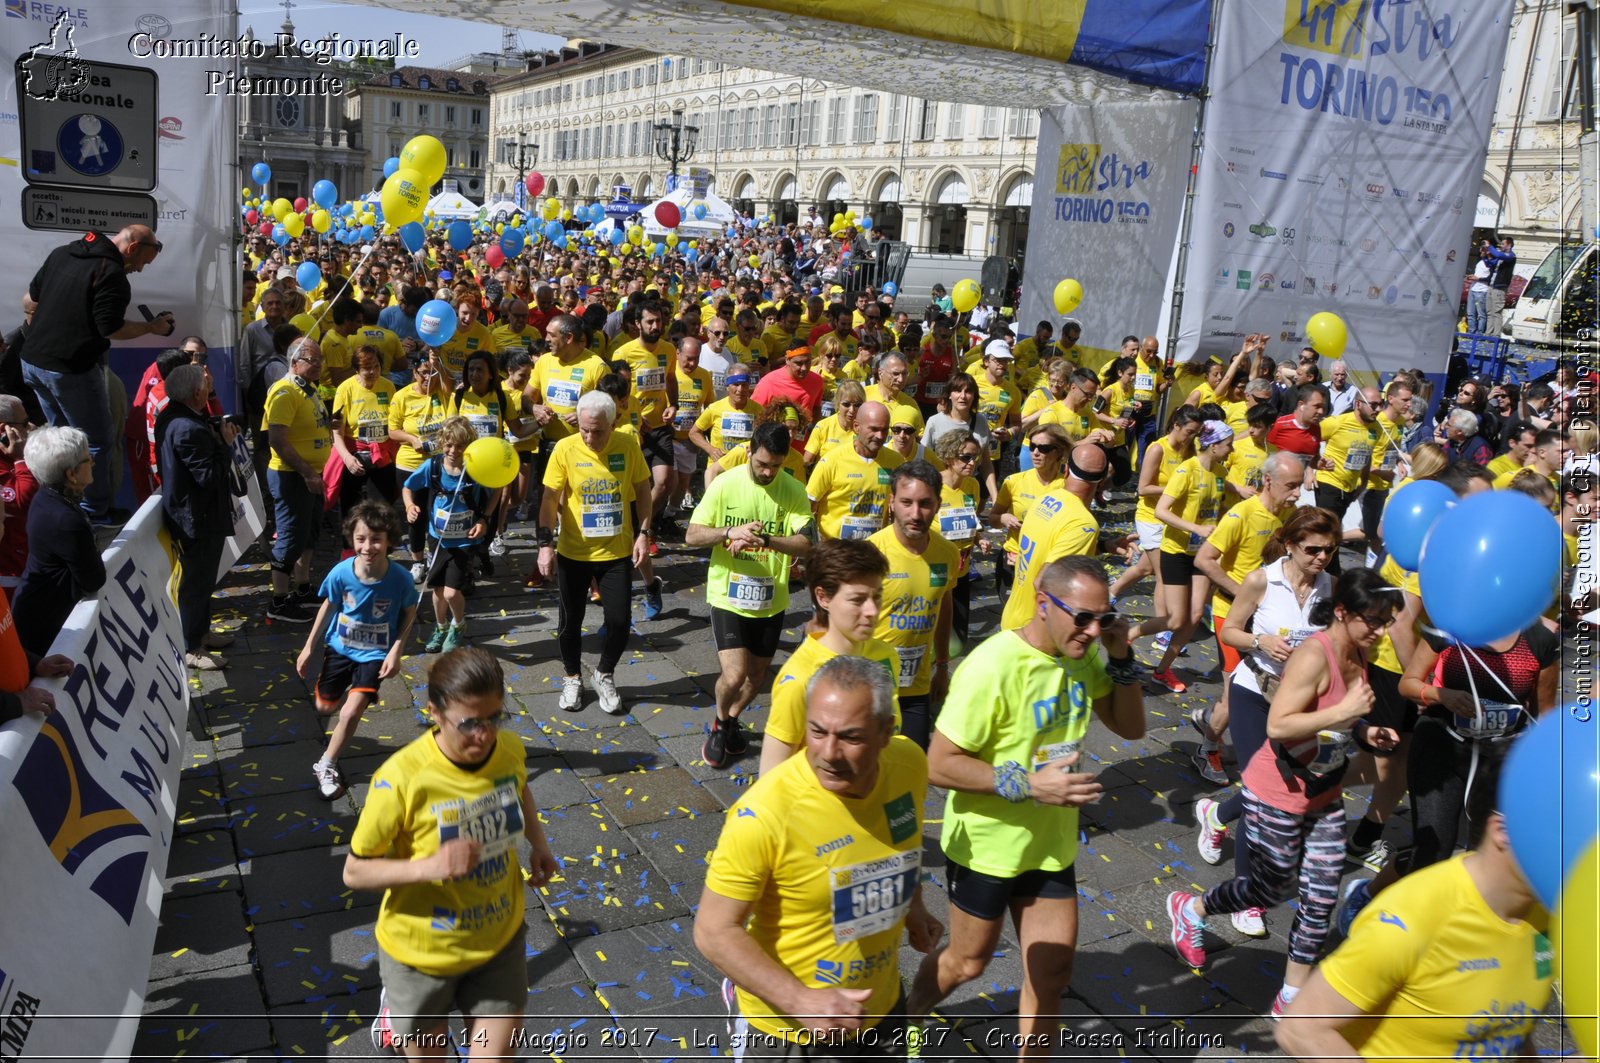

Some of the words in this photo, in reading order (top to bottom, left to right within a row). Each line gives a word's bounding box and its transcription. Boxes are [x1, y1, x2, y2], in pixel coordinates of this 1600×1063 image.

[31, 2, 88, 20] REALE
[31, 14, 88, 28] MUUA
[1279, 52, 1399, 126] TORINO
[1403, 117, 1417, 128] LA
[1417, 119, 1448, 135] STAMPA
[1097, 153, 1155, 191] Stra
[61, 205, 86, 215] veicoli
[88, 207, 108, 217] merci
[111, 209, 149, 220] autorizzati
[1055, 197, 1114, 224] TORINO
[1117, 201, 1150, 217] 150
[1280, 280, 1296, 289] Cuki
[581, 492, 622, 505] TORINO
[595, 516, 614, 527] 1312
[724, 515, 748, 527] RUN
[777, 521, 785, 535] A
[736, 584, 767, 601] 6960
[889, 613, 937, 631] TORINO
[63, 557, 160, 761] REALE
[120, 633, 184, 816] MUTUA
[851, 874, 905, 918] 5681
